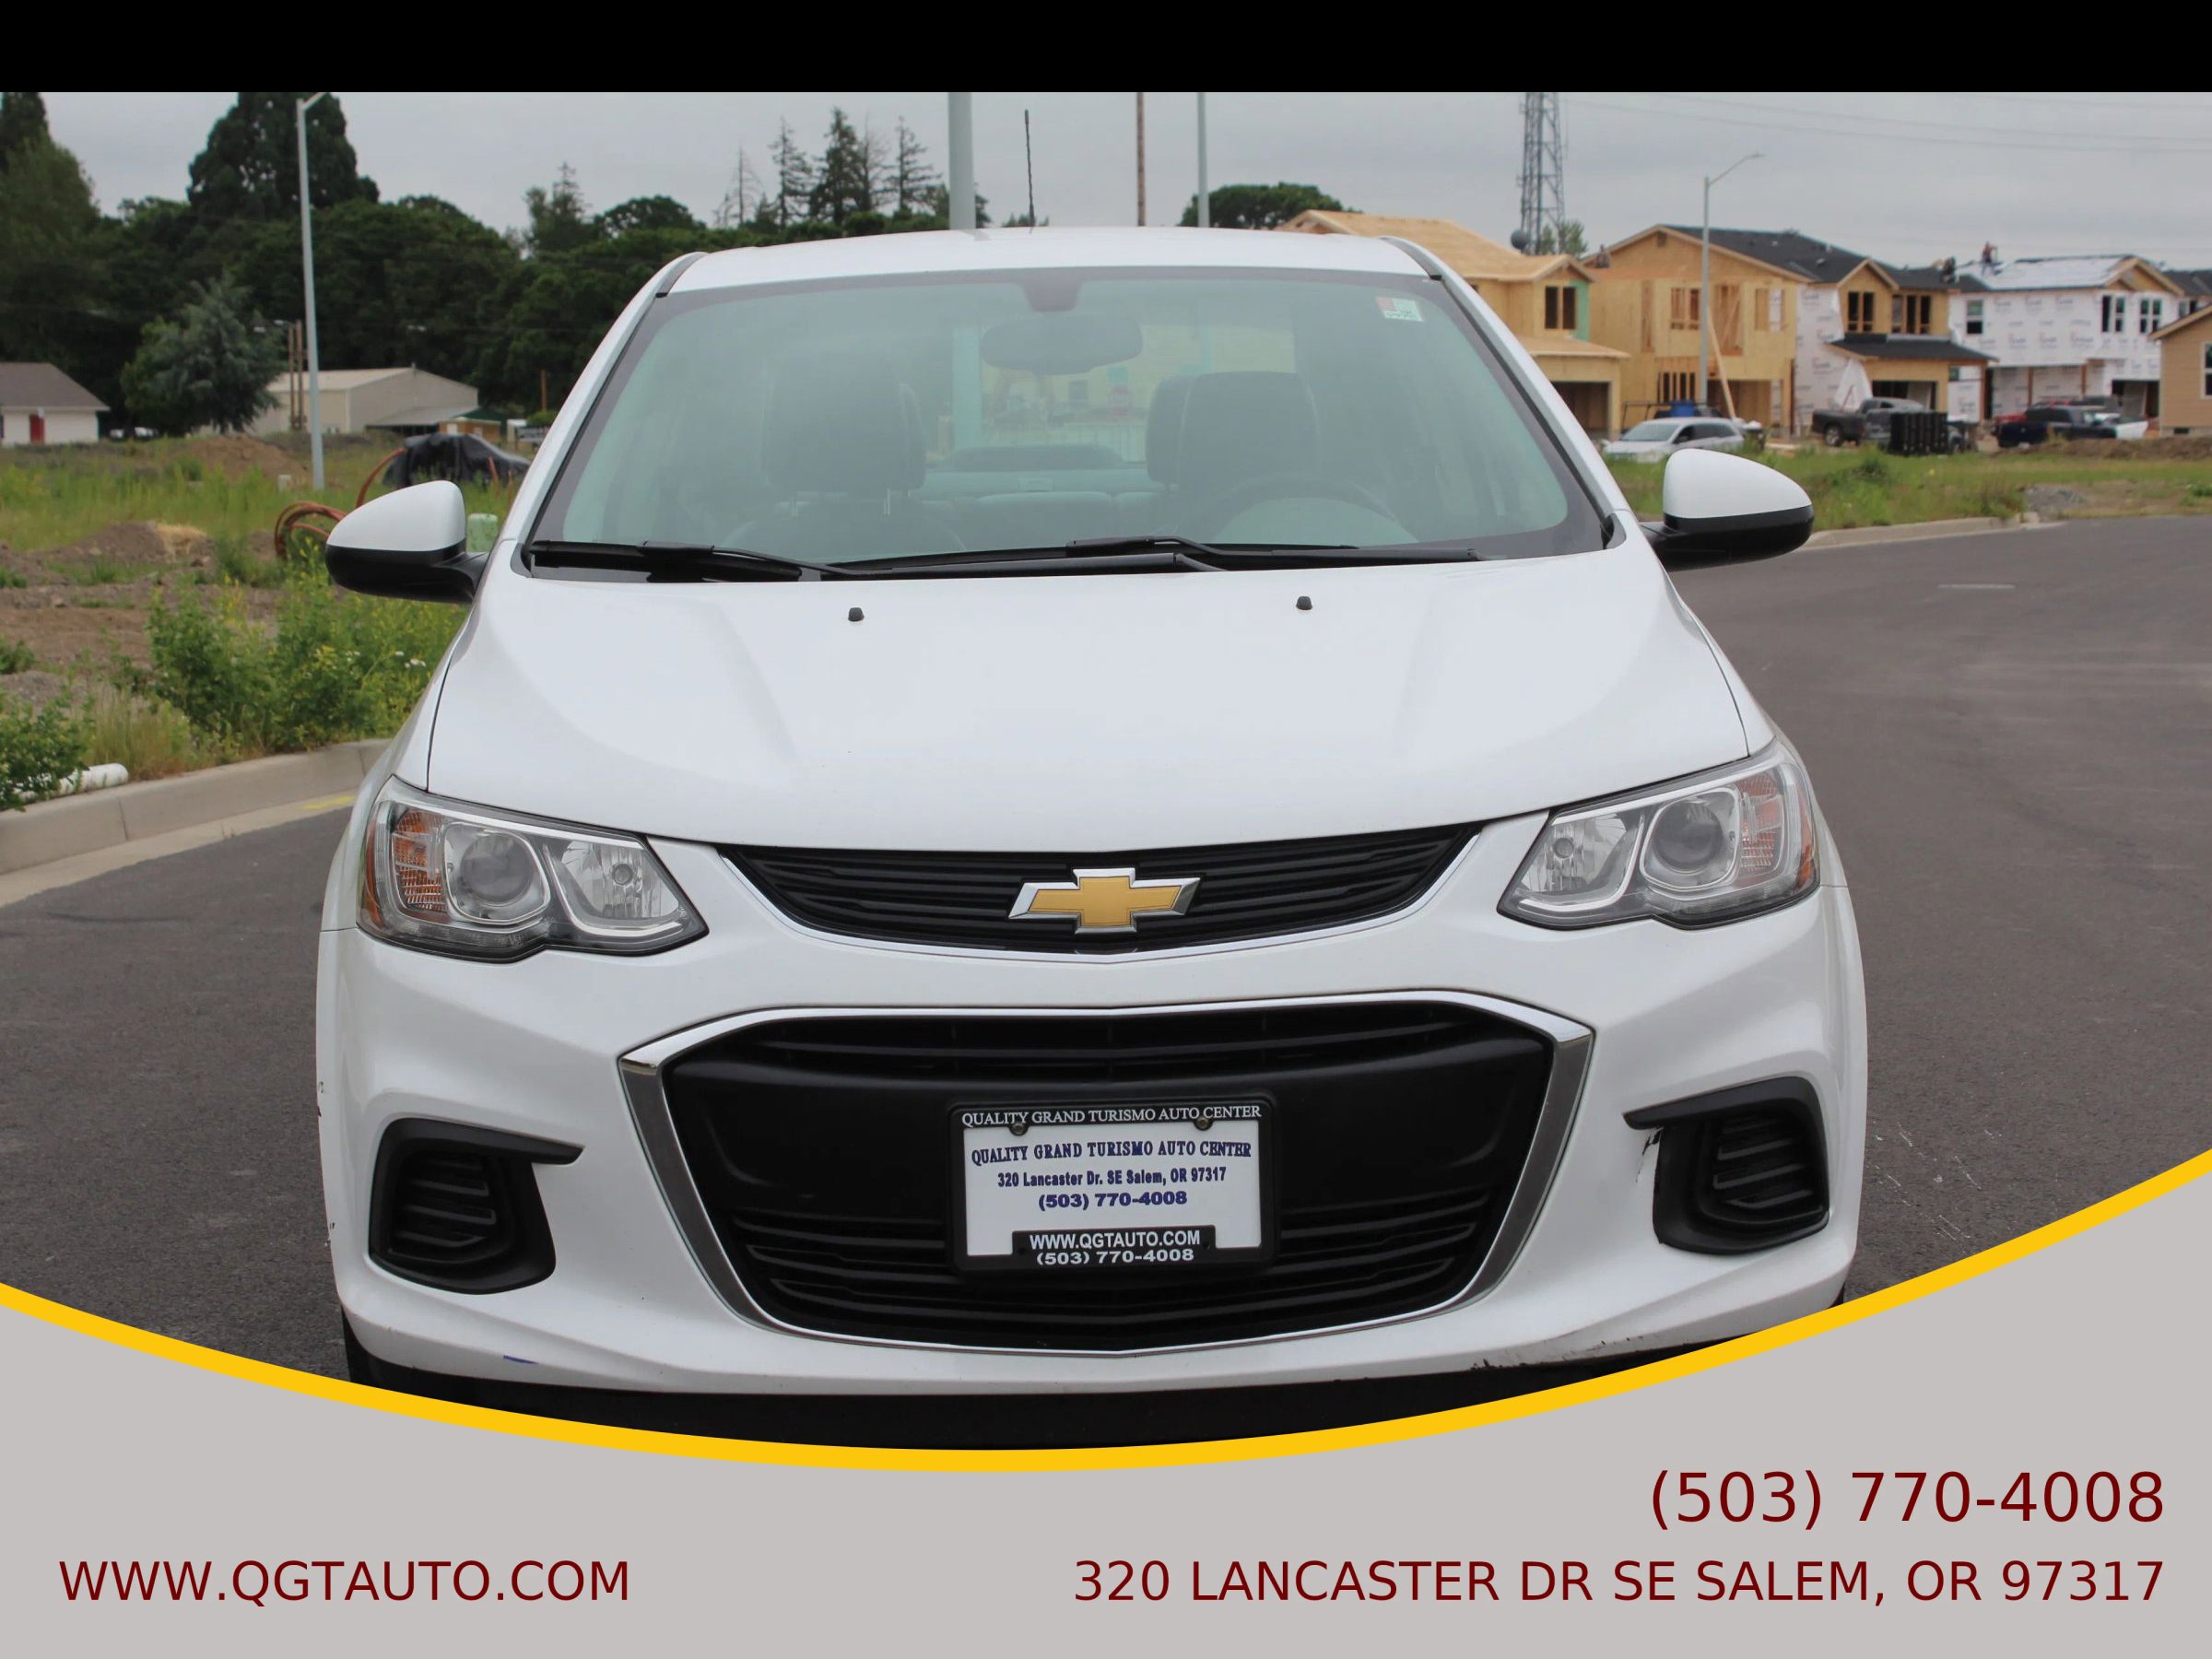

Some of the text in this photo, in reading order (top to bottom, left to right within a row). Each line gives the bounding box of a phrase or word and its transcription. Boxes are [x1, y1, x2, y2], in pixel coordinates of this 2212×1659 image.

[961, 1105, 1262, 1127] QUALITY GRAND TURISMO AUTO CENTER
[971, 1140, 1252, 1167] QUALITY GRAND TURISMO AUTO CENTER
[997, 1167, 1227, 1187] 320 Lancaster Dr. SE Salem, OR 97317
[1038, 1191, 1188, 1211] (503) 770-4008
[1029, 1230, 1201, 1251] WWW.QGTAUTO.COM
[1036, 1249, 1194, 1265] (503) 770-4008
